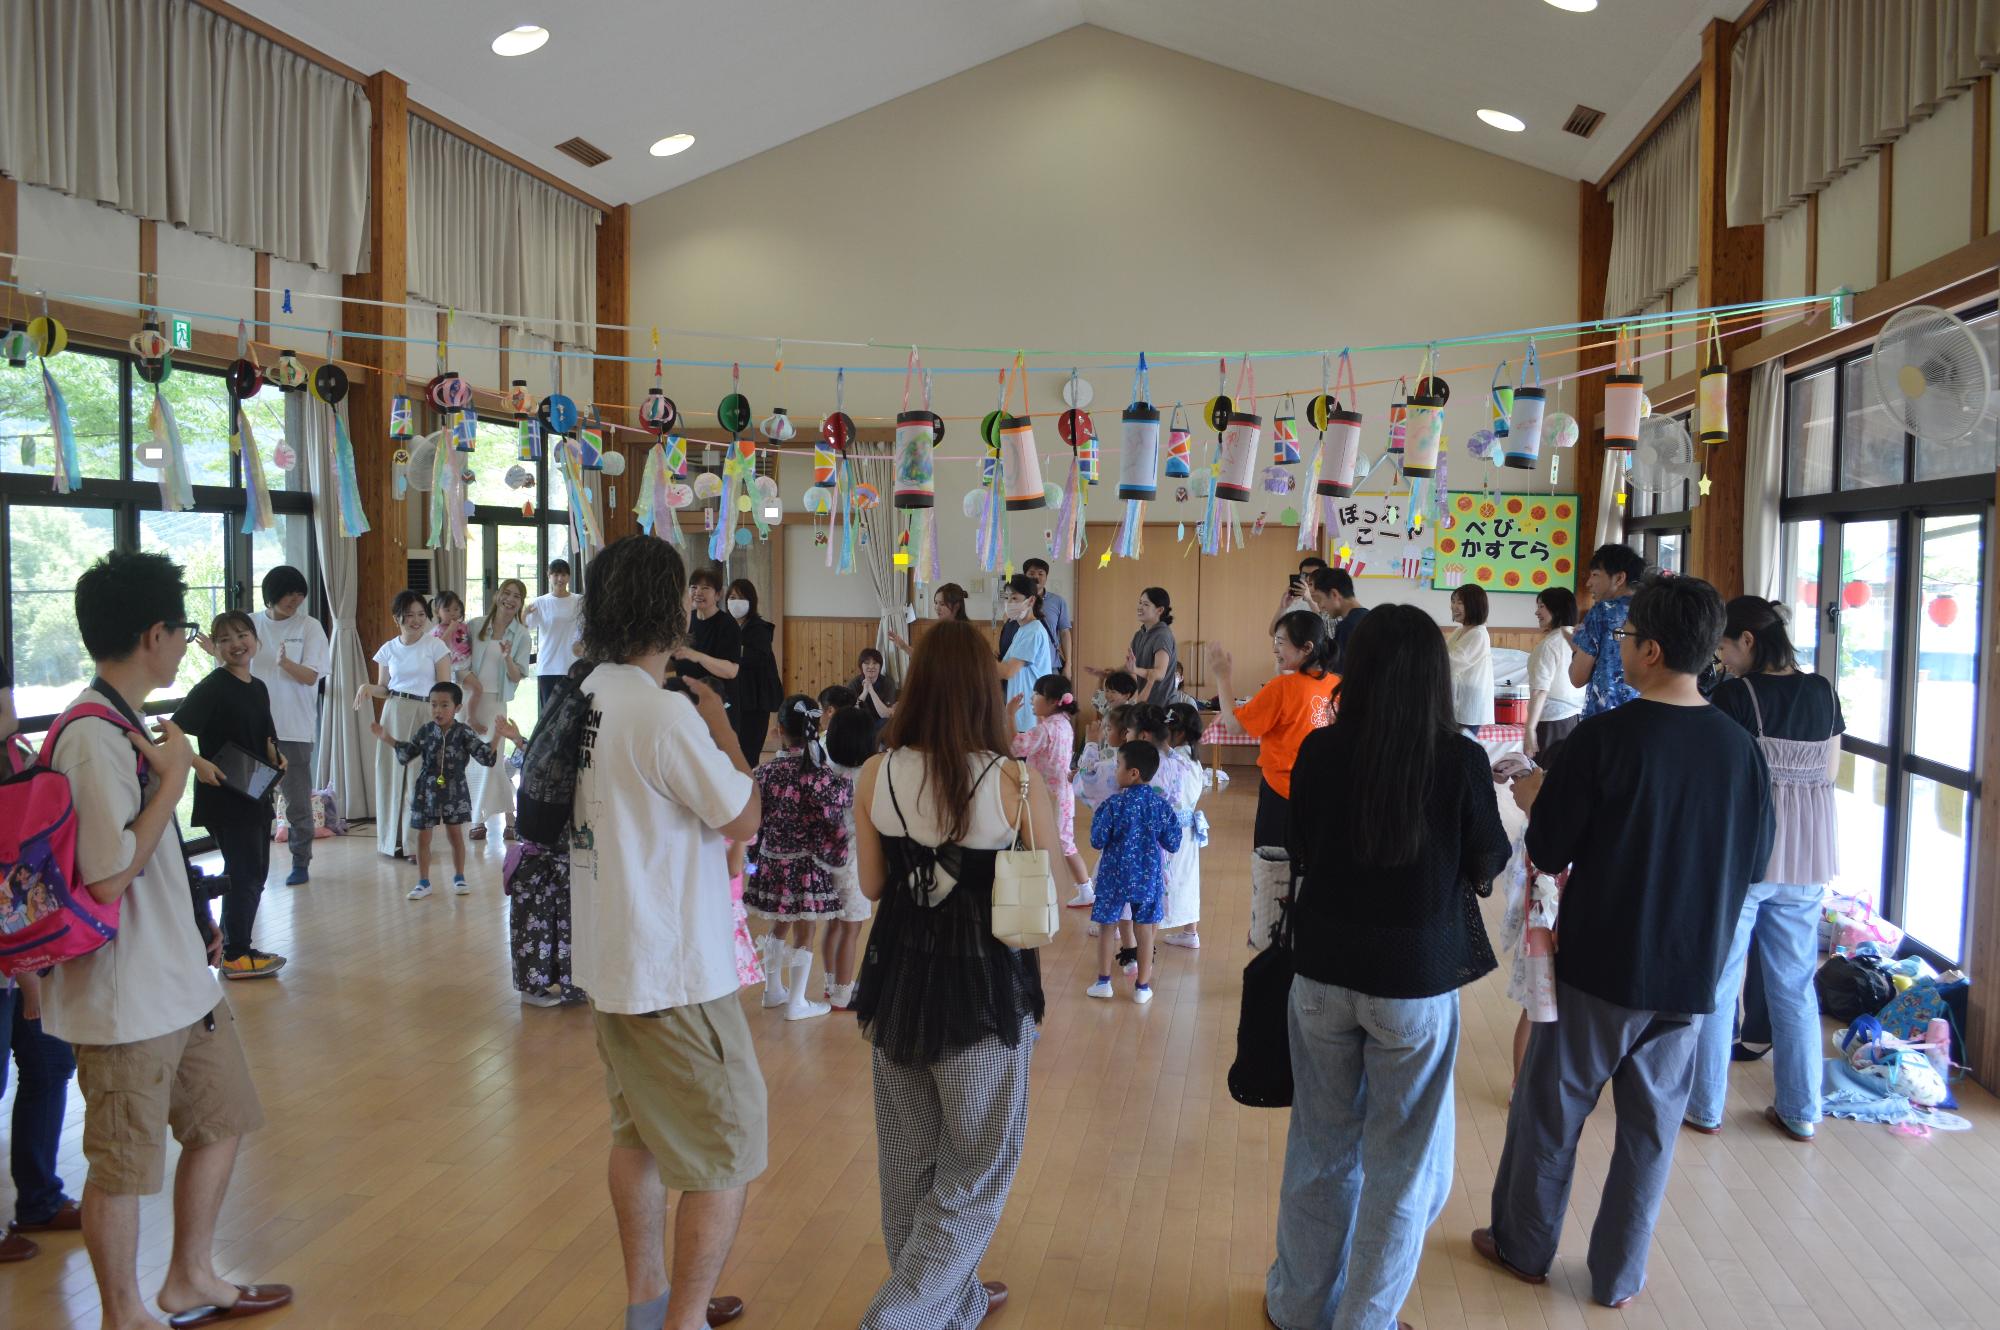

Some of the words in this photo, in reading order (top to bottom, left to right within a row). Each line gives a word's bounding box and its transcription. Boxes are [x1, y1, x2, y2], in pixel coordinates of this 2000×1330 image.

[1465, 518, 1538, 538] べび
[1461, 538, 1549, 561] かすてら
[585, 710, 602, 728] ON
